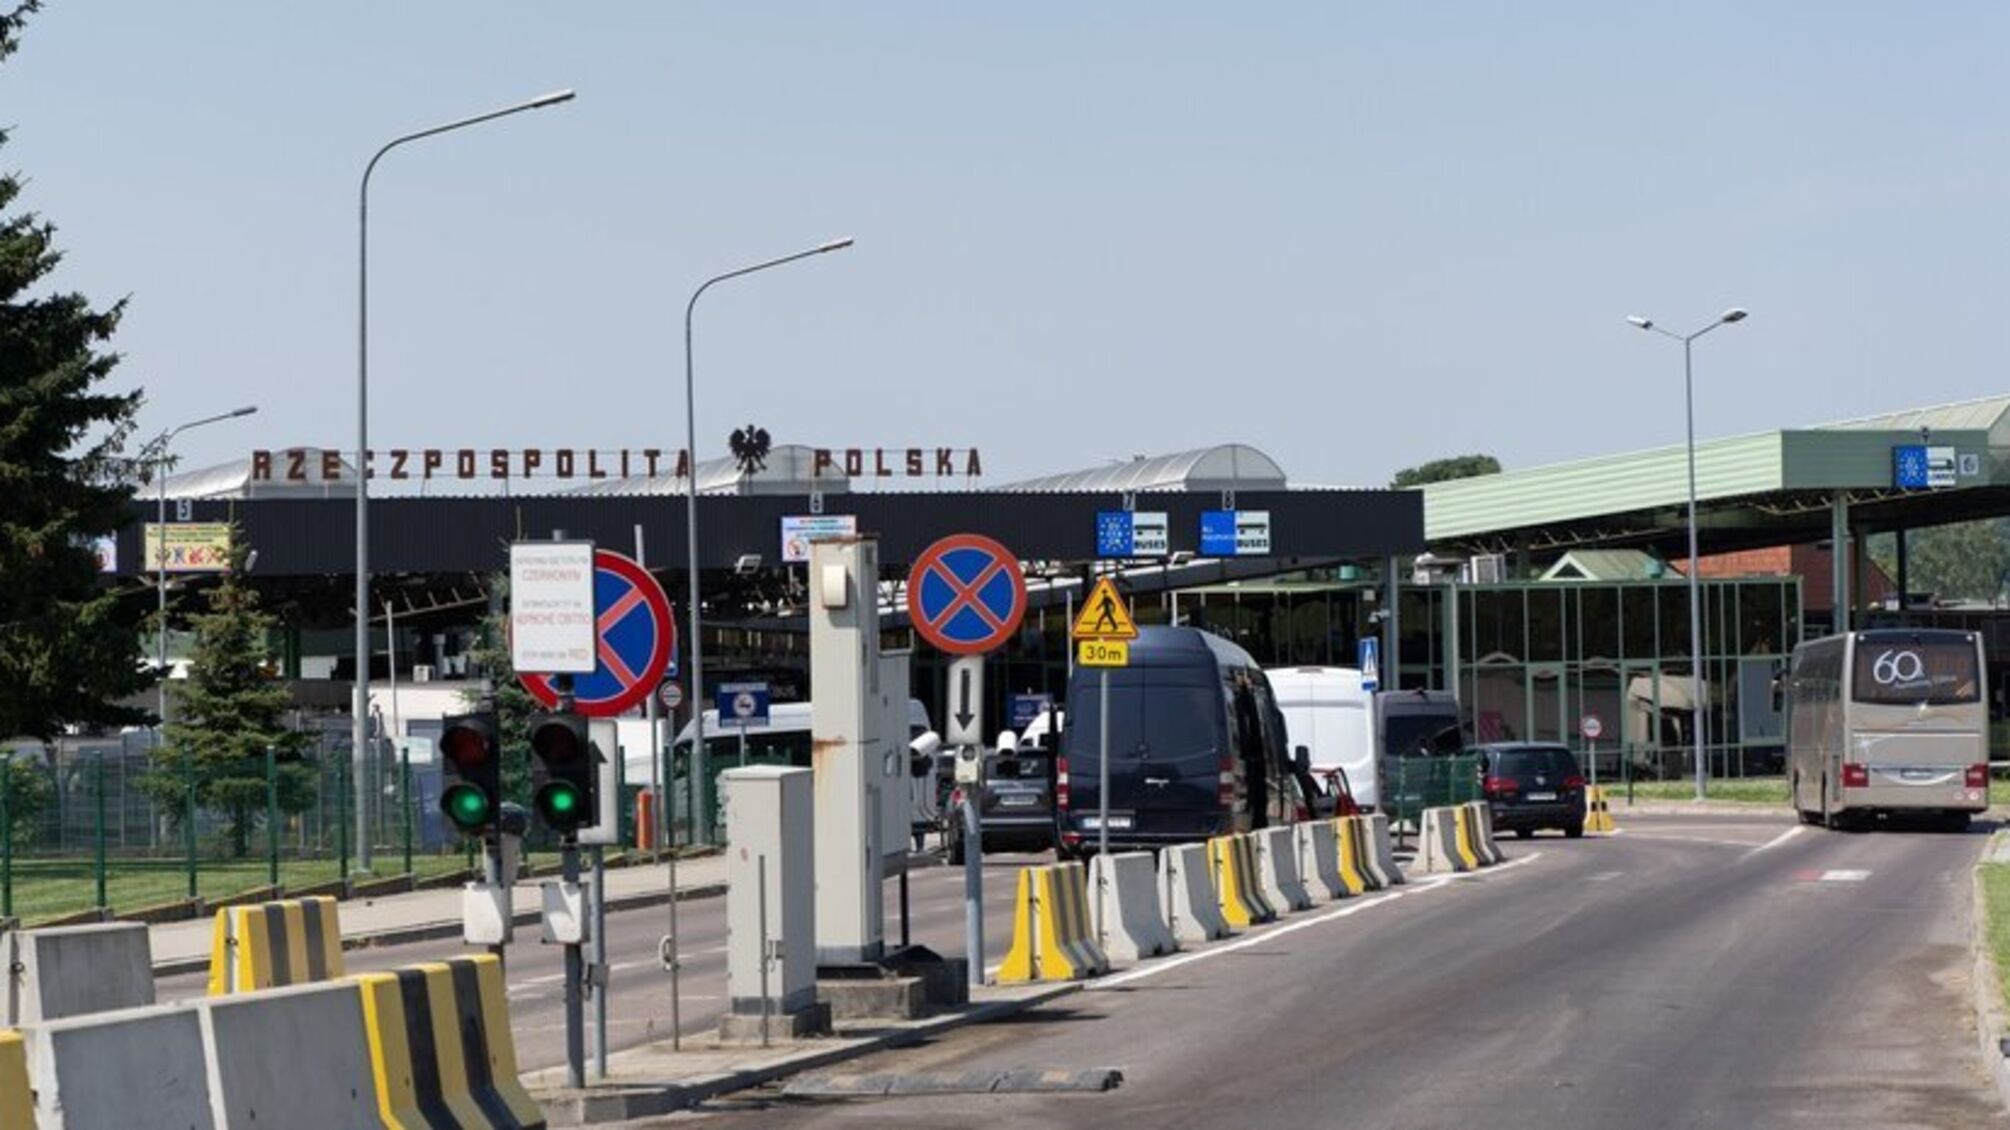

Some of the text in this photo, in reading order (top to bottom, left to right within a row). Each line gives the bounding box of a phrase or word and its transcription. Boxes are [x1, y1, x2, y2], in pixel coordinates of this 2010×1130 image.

[814, 449, 981, 477] POLSKA
[180, 500, 188, 518] 5
[1134, 540, 1166, 549] BUSES
[1236, 539, 1268, 548] BUSES
[1086, 645, 1122, 660] 30m
[1873, 649, 1921, 684] 60
